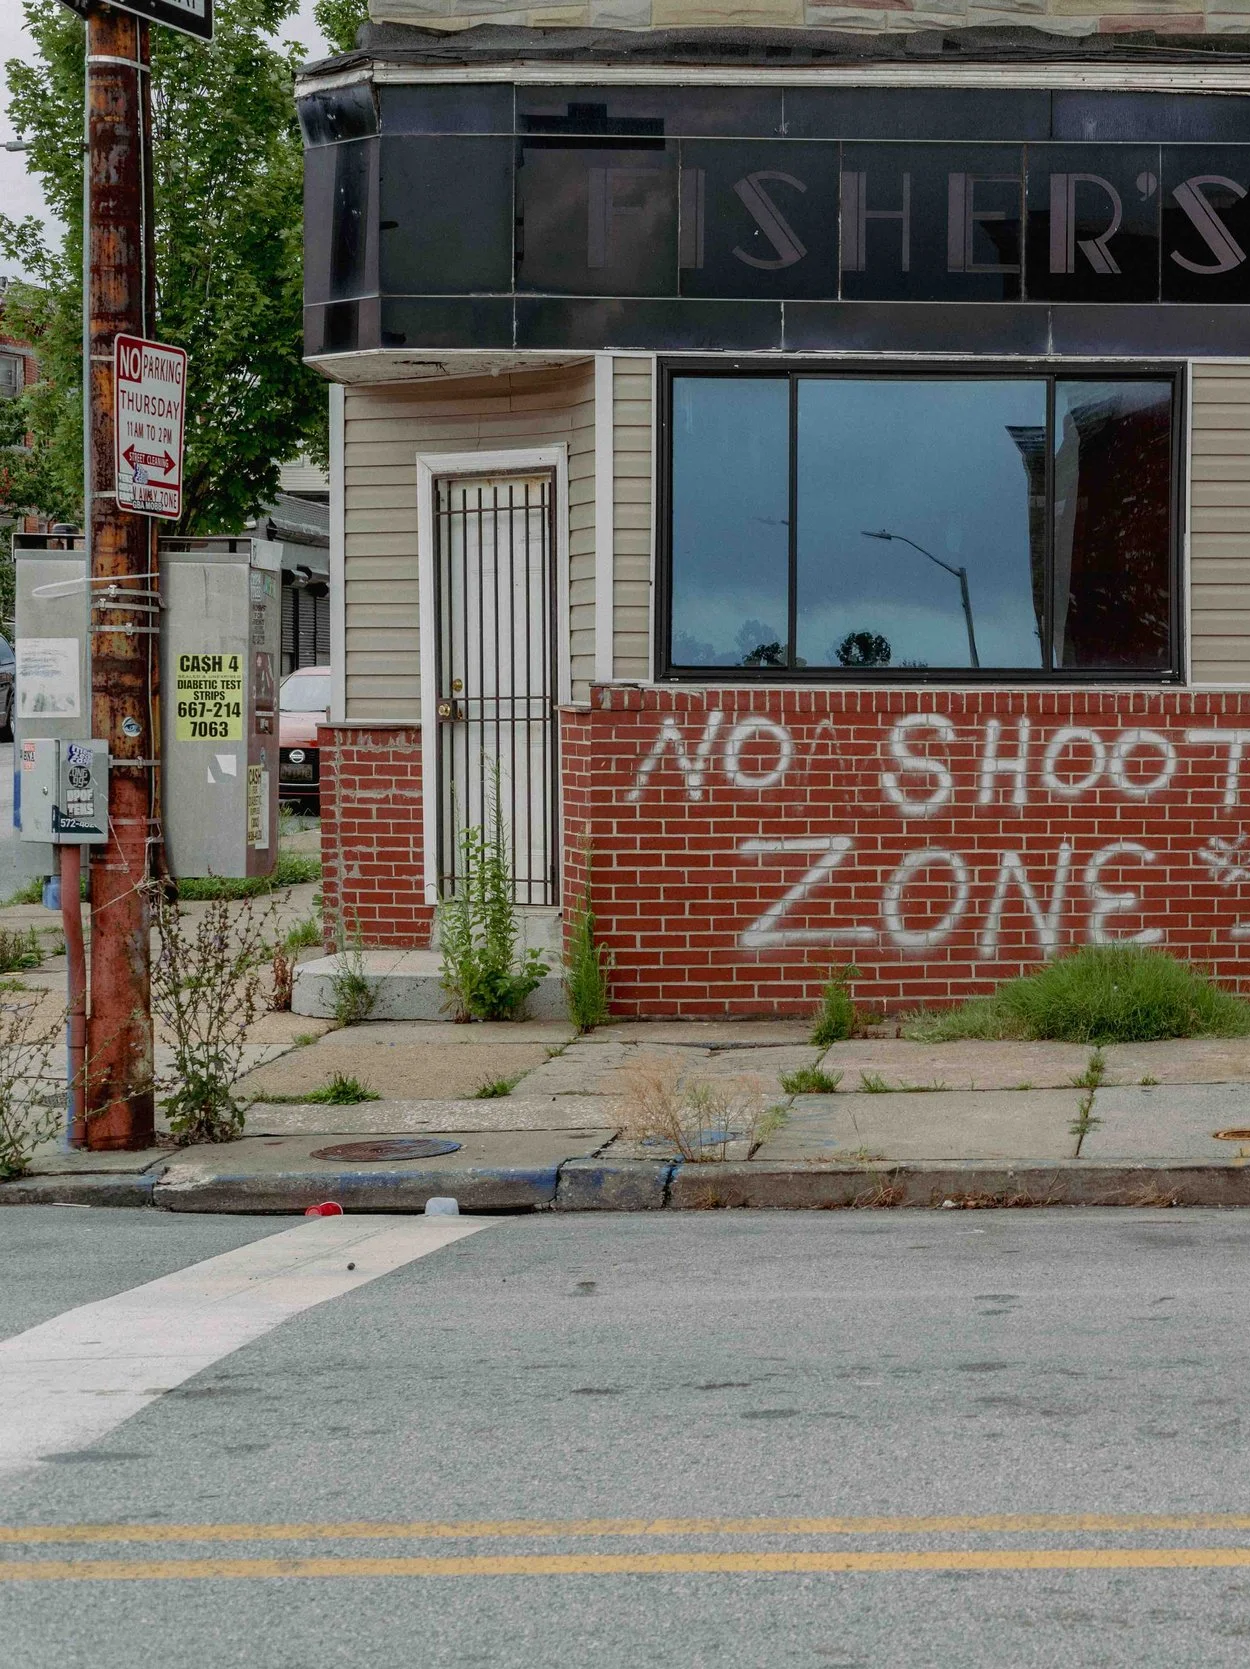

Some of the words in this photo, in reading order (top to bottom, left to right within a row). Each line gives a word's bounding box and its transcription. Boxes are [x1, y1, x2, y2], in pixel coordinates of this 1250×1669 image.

[587, 168, 1249, 275] FISHER'S
[120, 345, 141, 380] NO
[142, 354, 181, 385] PARKING
[120, 389, 180, 420] THURSDAY
[146, 425, 156, 441] TO
[129, 451, 146, 464] STREET
[146, 455, 170, 469] CLEANING
[160, 491, 177, 509] ZONE
[180, 654, 223, 674] CA$H
[228, 655, 239, 672] 4
[177, 680, 218, 690] DIABETIC
[220, 680, 242, 690] TEST
[193, 690, 226, 701] STRIPS
[178, 701, 242, 718] 667-214
[190, 721, 229, 737] 7063
[625, 707, 795, 801] NO
[738, 835, 1166, 961] ZONE
